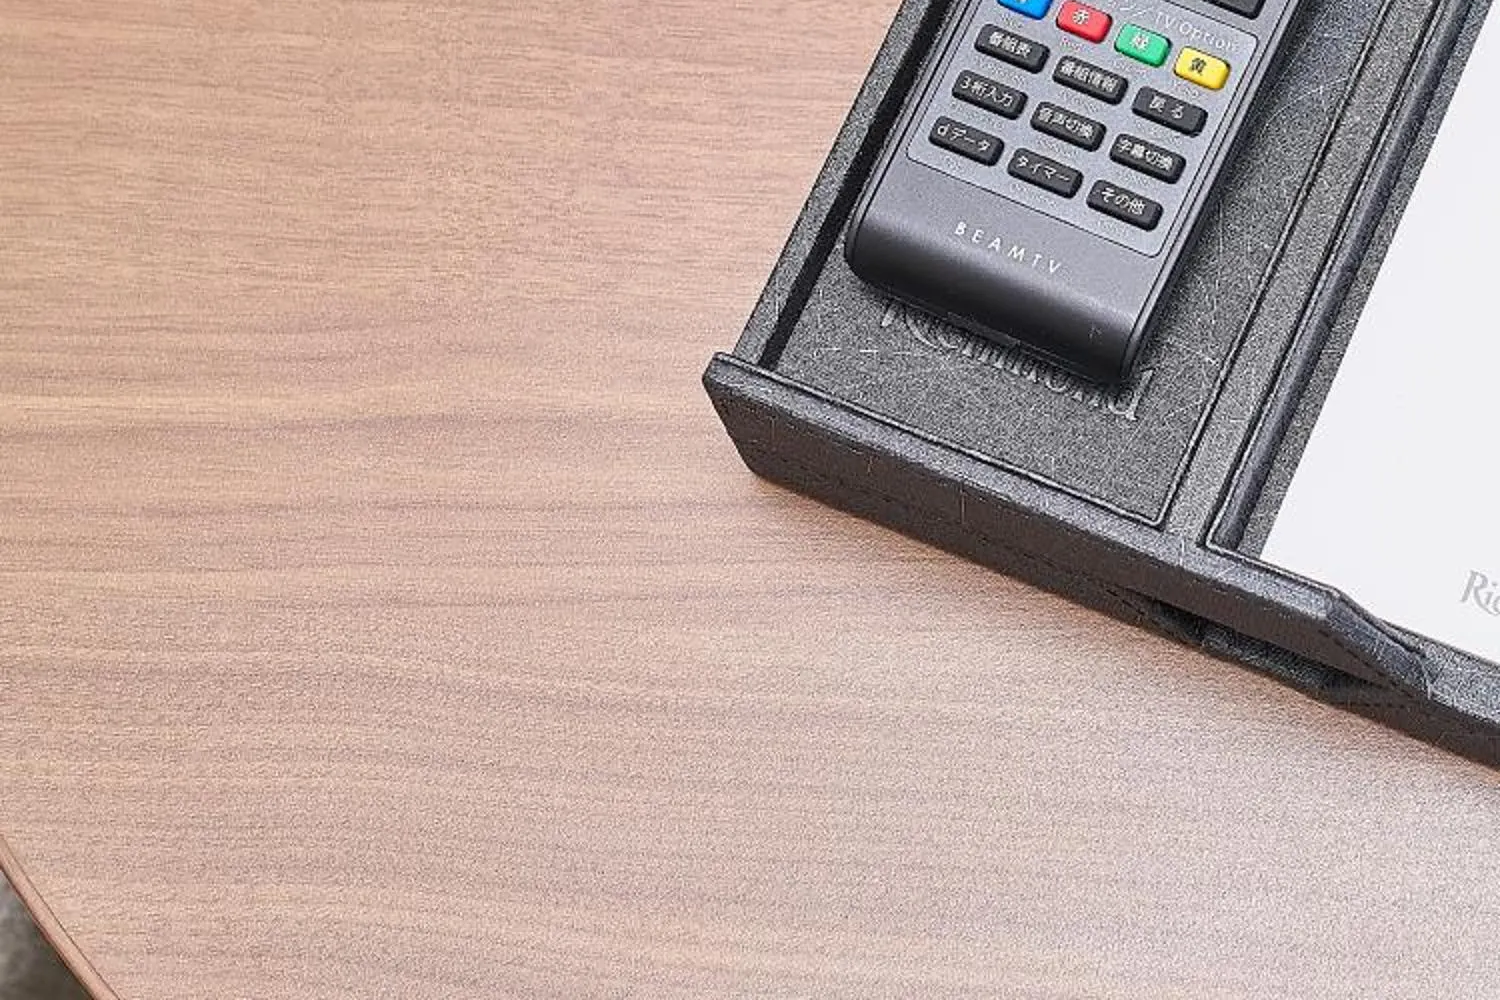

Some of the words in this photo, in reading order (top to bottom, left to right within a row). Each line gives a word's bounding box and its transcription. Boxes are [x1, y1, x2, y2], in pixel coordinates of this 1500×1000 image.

[1015, 154, 1071, 183] タイマー
[1100, 187, 1145, 215] その他
